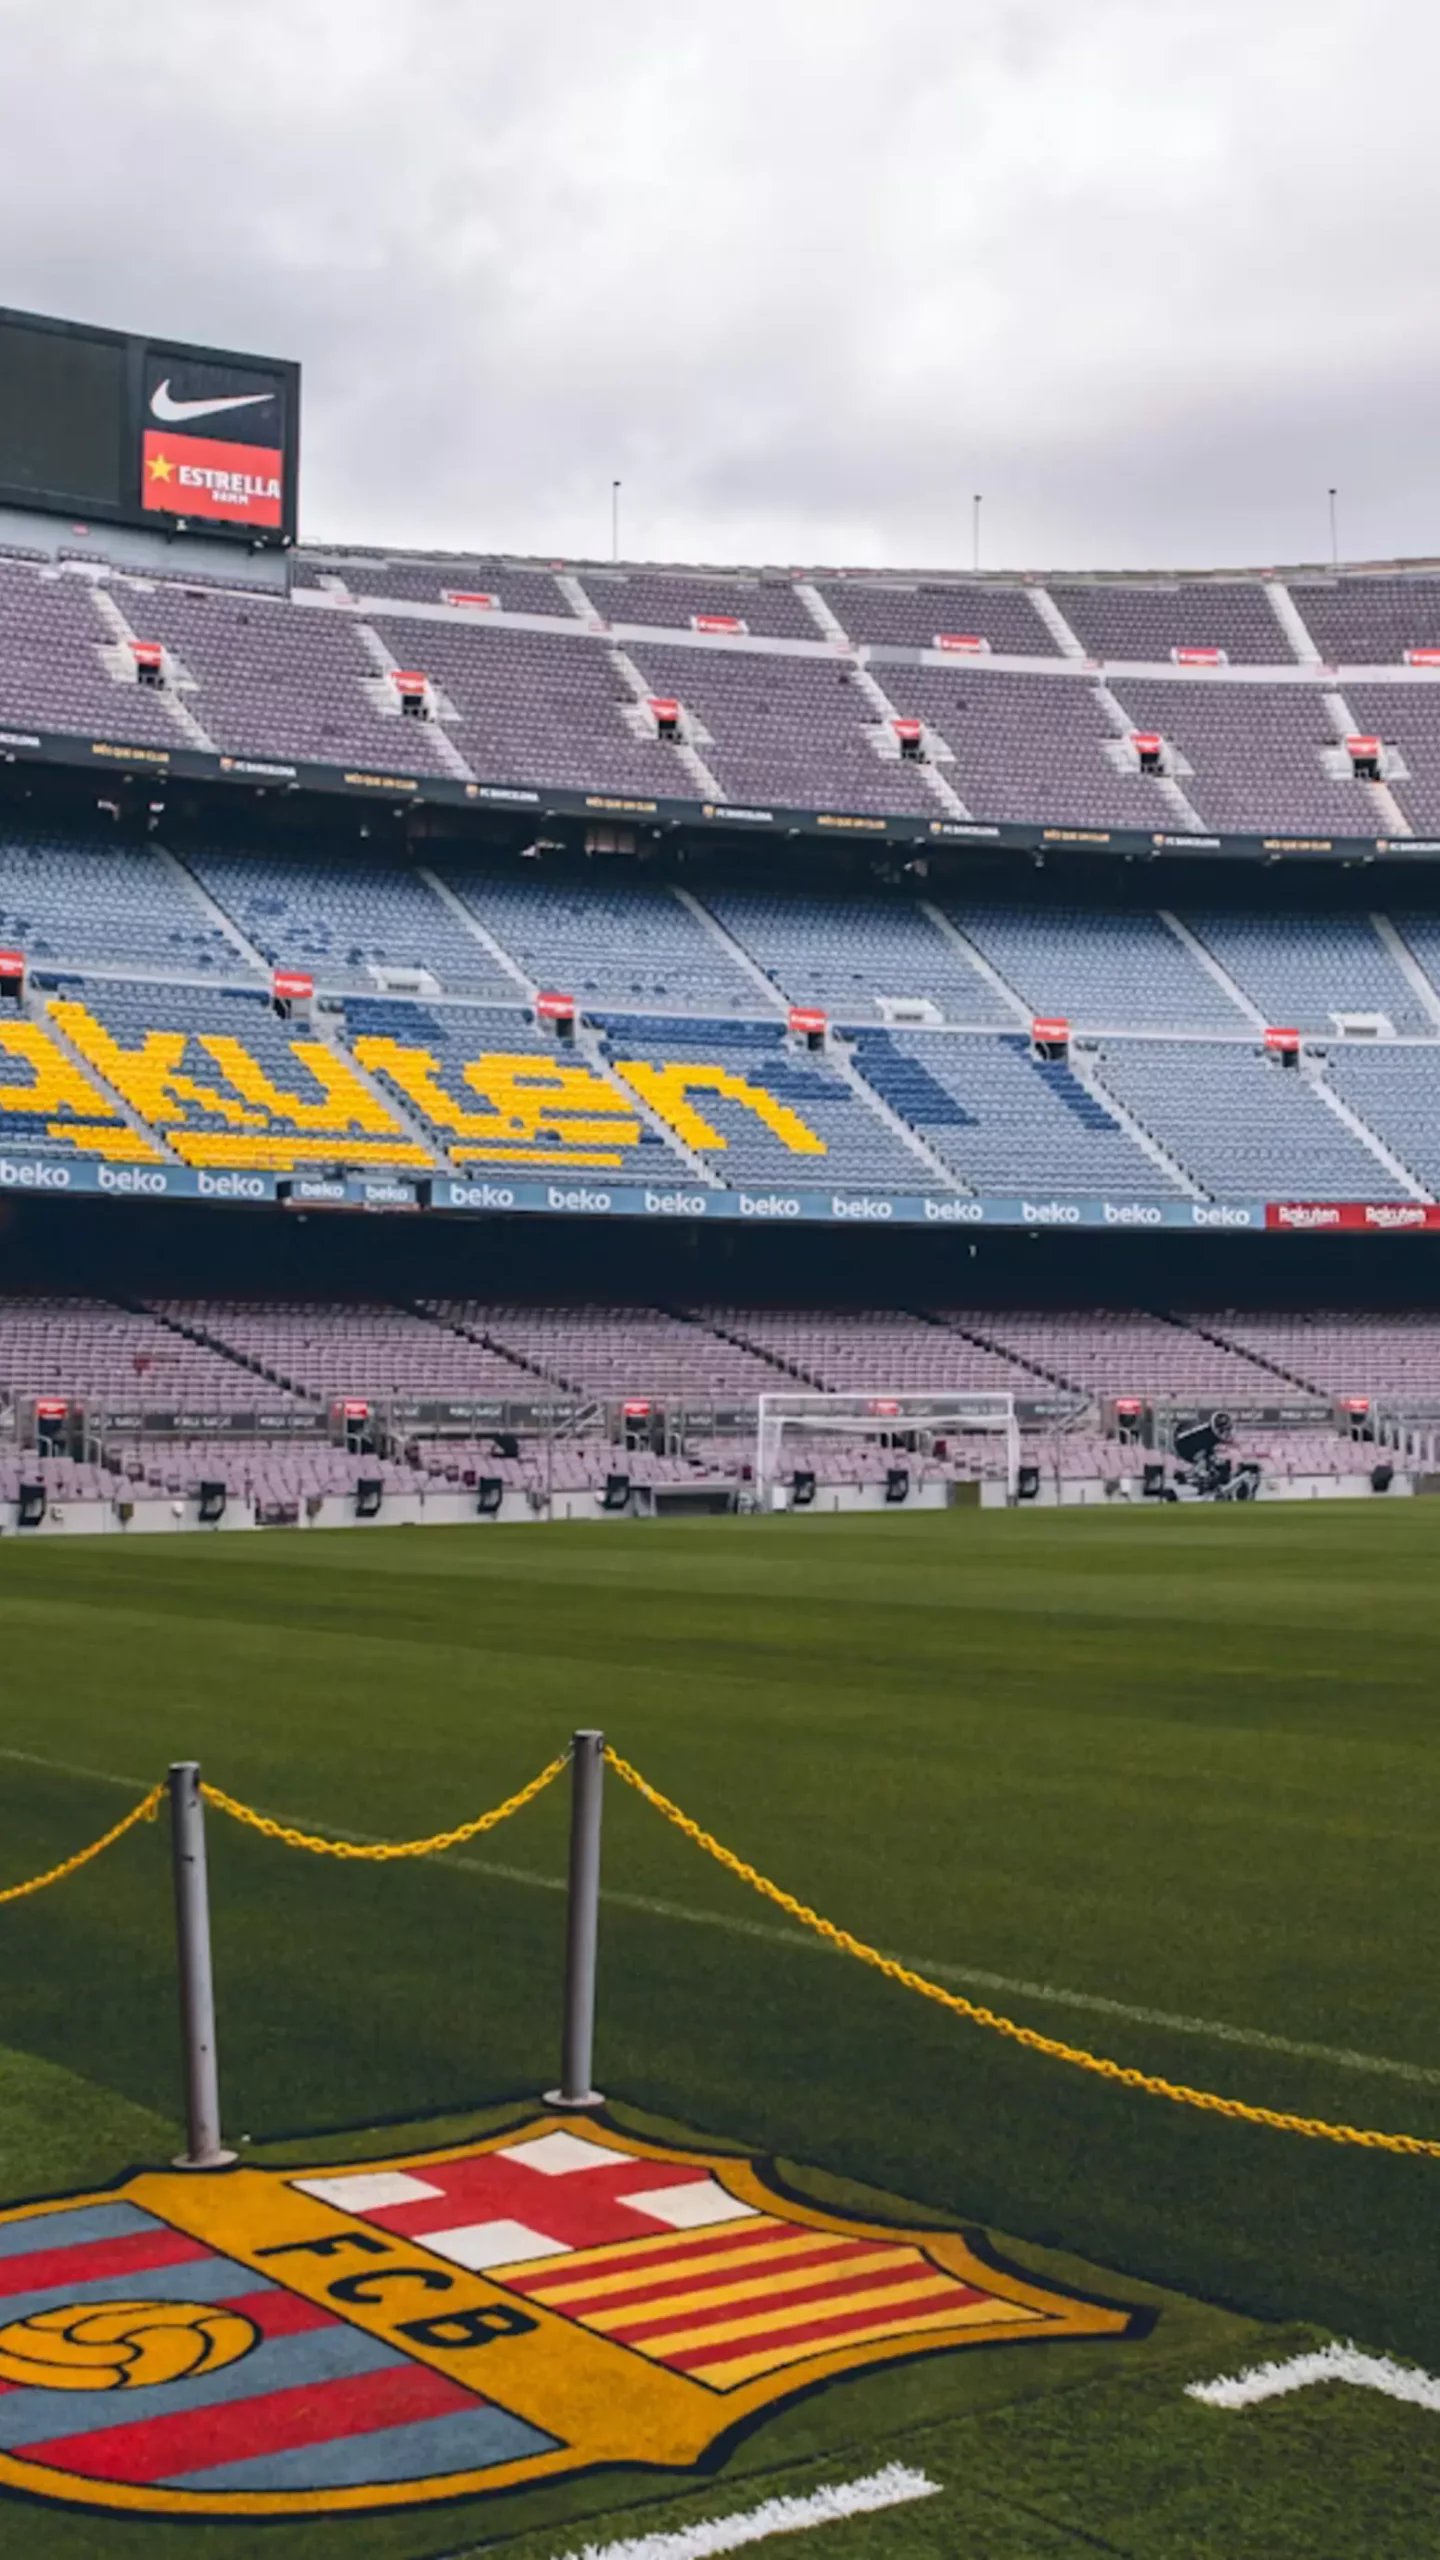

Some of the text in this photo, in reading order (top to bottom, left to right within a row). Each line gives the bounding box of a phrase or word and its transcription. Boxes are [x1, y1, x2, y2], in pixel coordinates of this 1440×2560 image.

[179, 465, 281, 498] ESTRELLA
[0, 1160, 70, 1187] beko
[98, 1165, 167, 1192] beko
[198, 1171, 265, 1197] beko
[300, 1181, 345, 1198] beko
[364, 1185, 408, 1201] beko
[450, 1184, 514, 1207] beko
[548, 1187, 611, 1211] beko
[644, 1191, 706, 1214] beko
[739, 1194, 800, 1216] beko
[832, 1197, 892, 1218] beko
[924, 1199, 983, 1221] beko
[1022, 1202, 1081, 1223] beko
[1103, 1203, 1162, 1224] beko
[1192, 1205, 1251, 1226] beko
[1278, 1206, 1340, 1228] Rakuten
[1365, 1206, 1427, 1228] Rakuten
[252, 2231, 541, 2349] FCB
